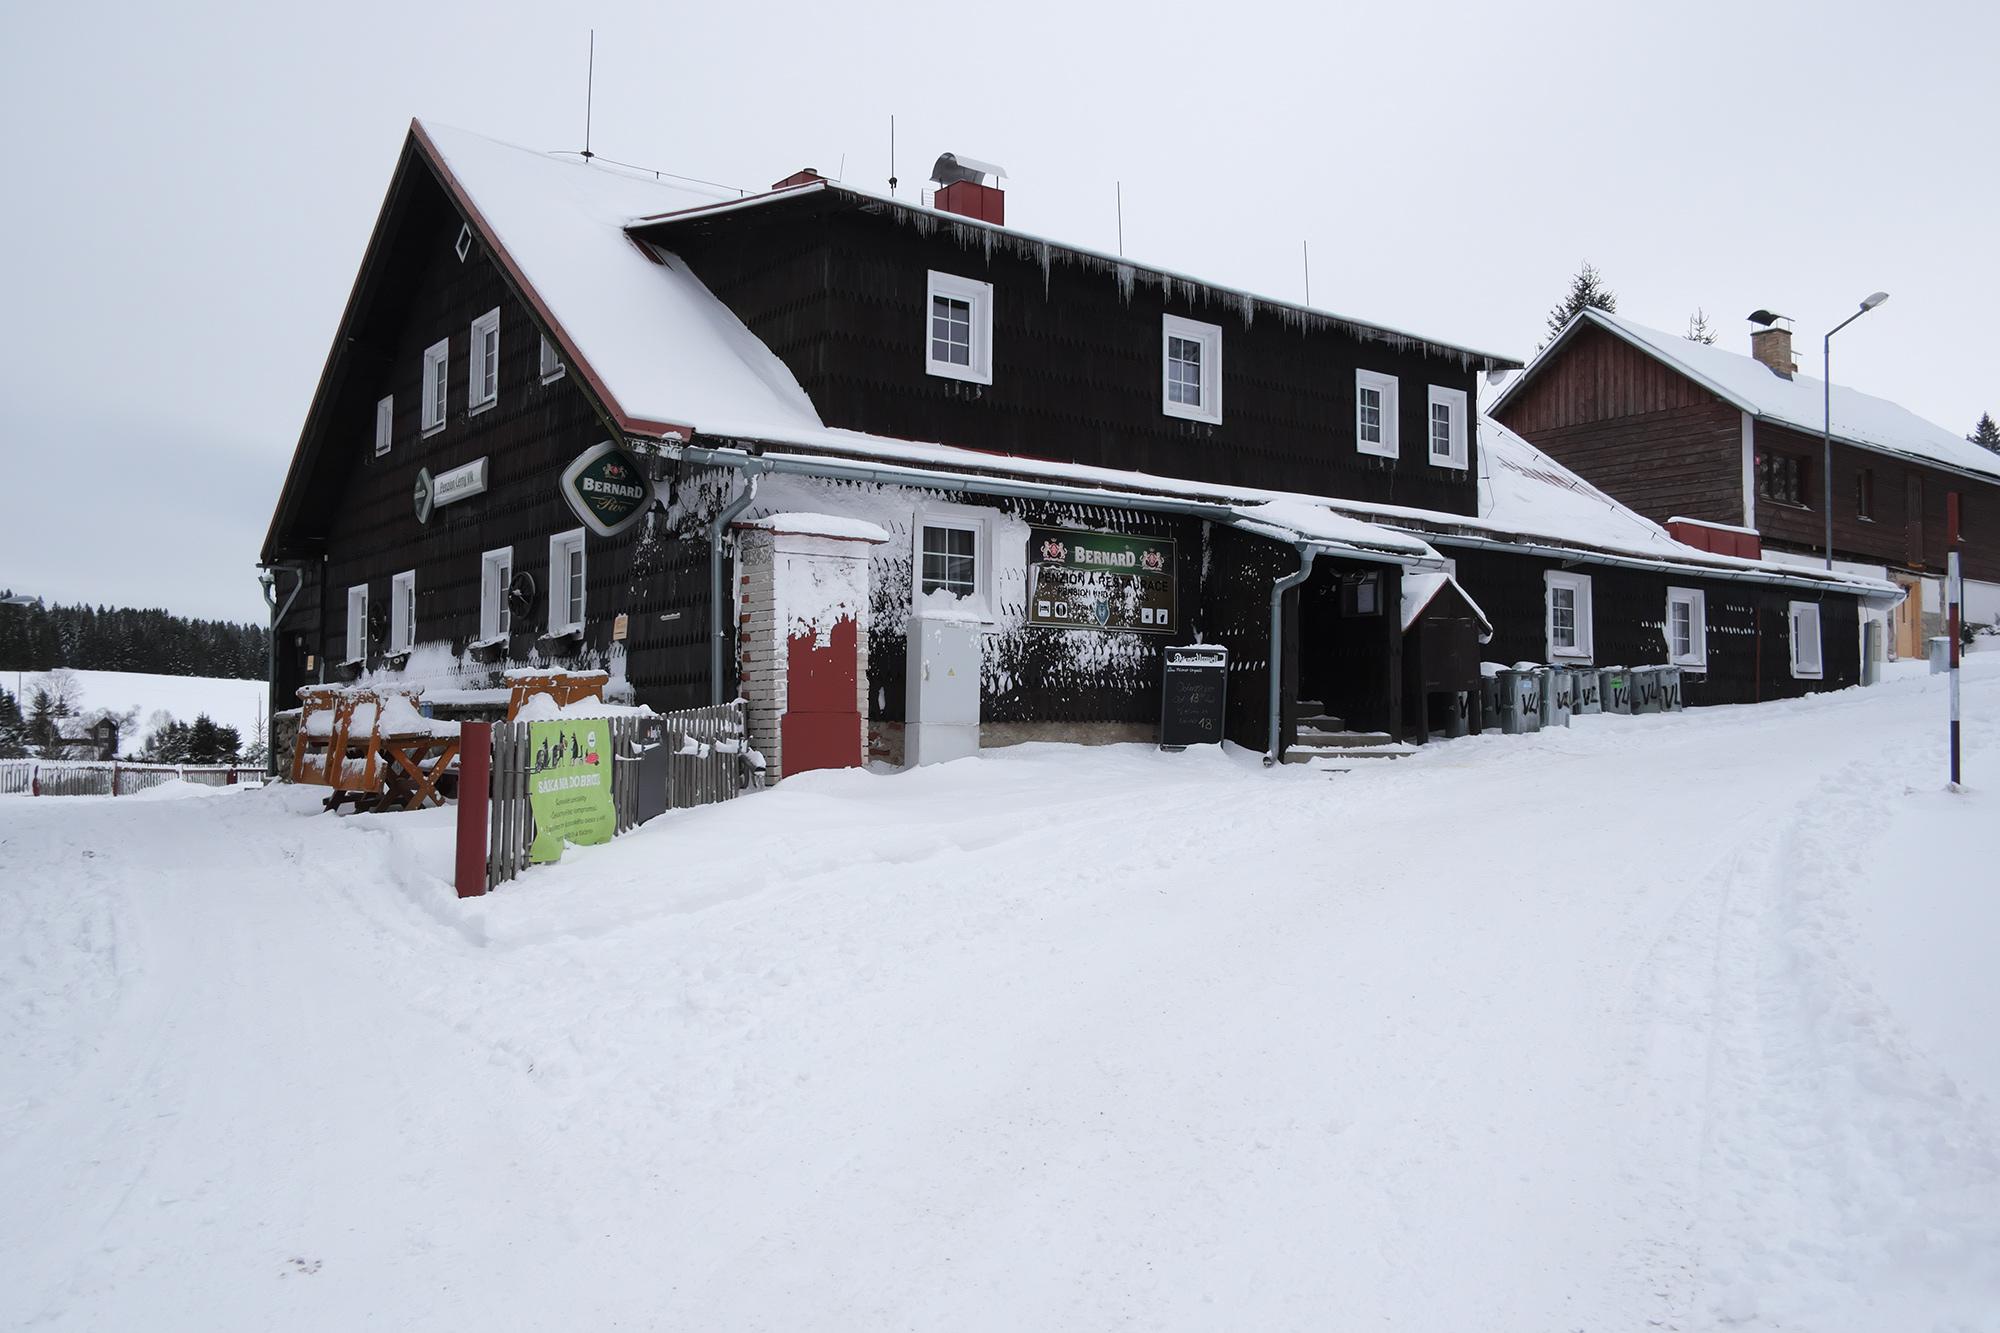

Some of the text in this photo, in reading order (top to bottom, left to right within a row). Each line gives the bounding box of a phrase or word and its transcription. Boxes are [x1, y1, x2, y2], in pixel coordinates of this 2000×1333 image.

[583, 477, 643, 499] BERNARD
[1075, 546, 1136, 567] BERNARD
[1039, 570, 1169, 592] PENZION A RESTAURACE
